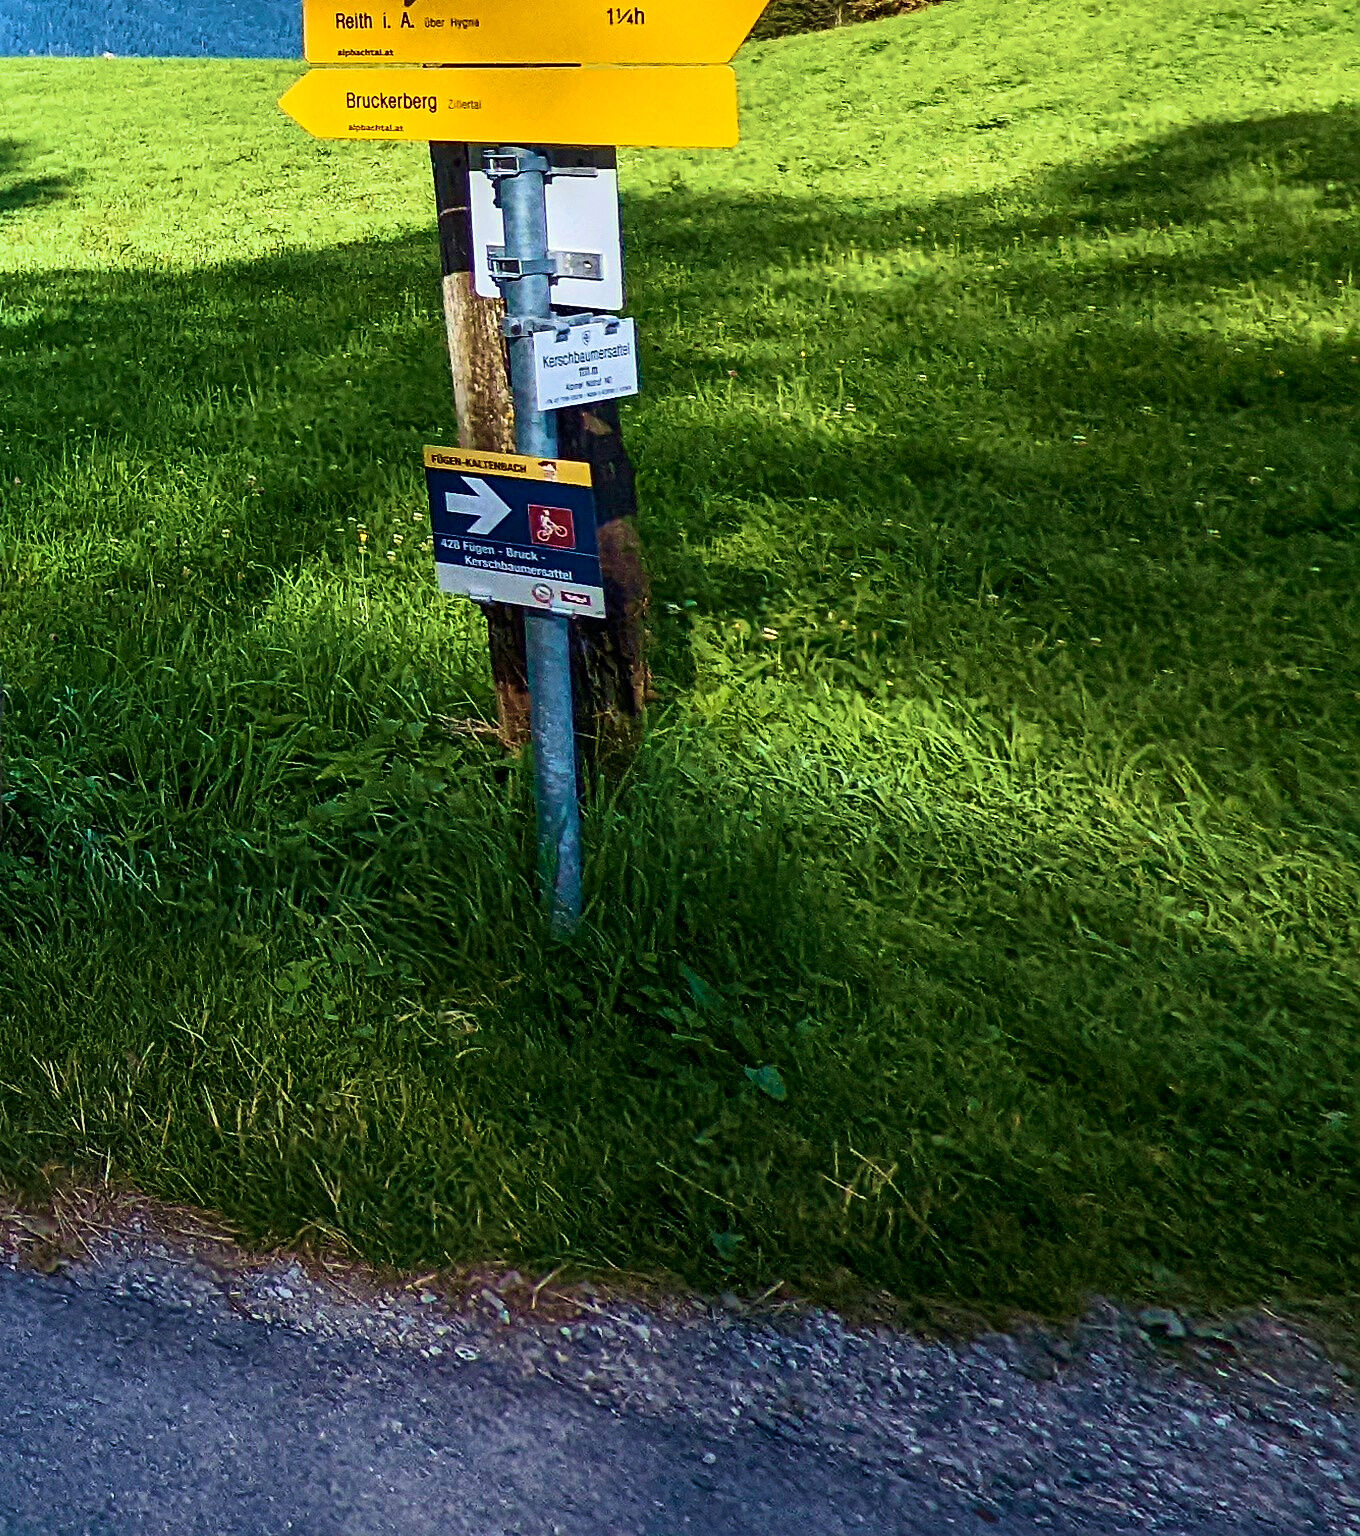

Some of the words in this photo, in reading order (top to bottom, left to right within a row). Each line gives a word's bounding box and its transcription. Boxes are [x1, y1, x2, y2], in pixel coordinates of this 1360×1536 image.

[335, 12, 373, 30] Reith
[383, 11, 391, 29] i.
[401, 11, 415, 29] A.
[346, 92, 437, 113] Bruckerberg
[506, 547, 539, 561] Bruck
[464, 555, 573, 581] Kerschbaumersattel
